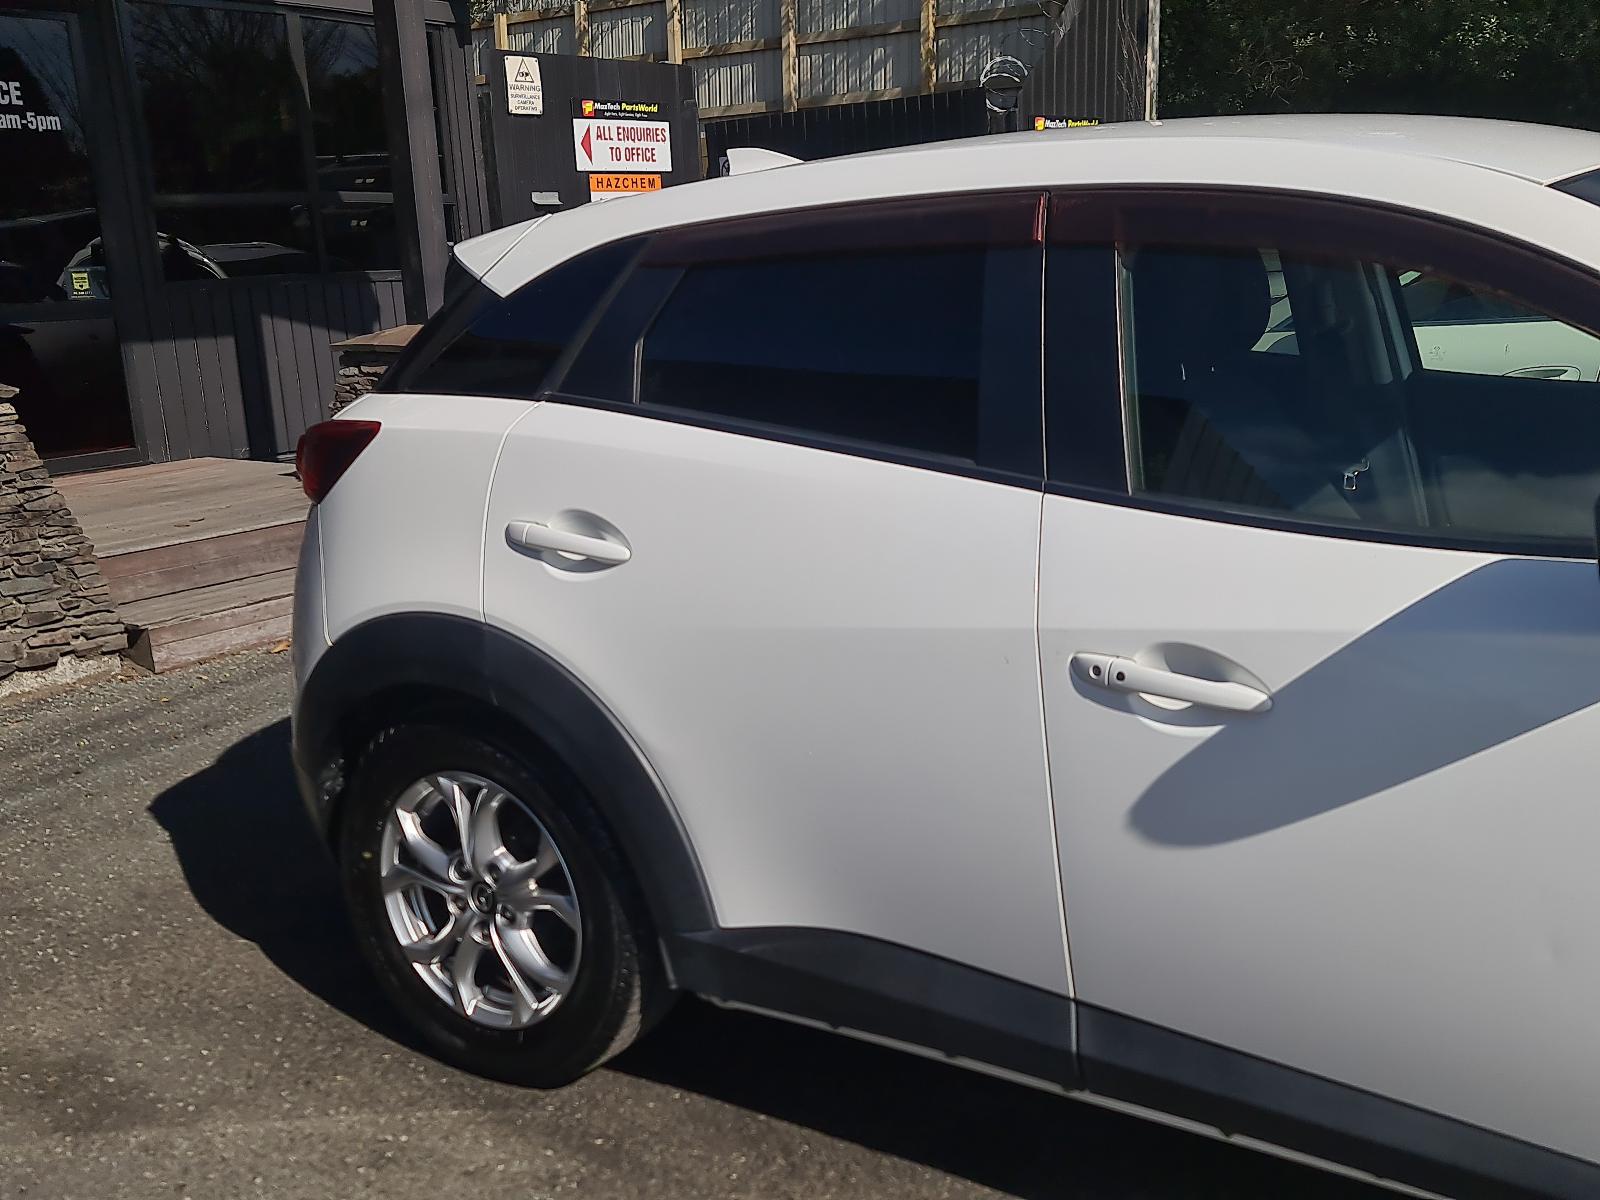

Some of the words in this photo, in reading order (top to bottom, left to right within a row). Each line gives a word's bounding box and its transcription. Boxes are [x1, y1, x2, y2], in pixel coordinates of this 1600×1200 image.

[0, 81, 24, 106] CE
[509, 84, 541, 92] WARNING
[594, 102, 620, 111] MaxTech
[621, 102, 658, 113] PartsWorld
[1044, 118, 1067, 128] MaxTech
[596, 126, 614, 141] ALL
[616, 126, 667, 143] ENQUIRIES
[609, 146, 622, 162] TO
[624, 147, 657, 163] OFFICE
[596, 177, 657, 189] HAZCHEM
